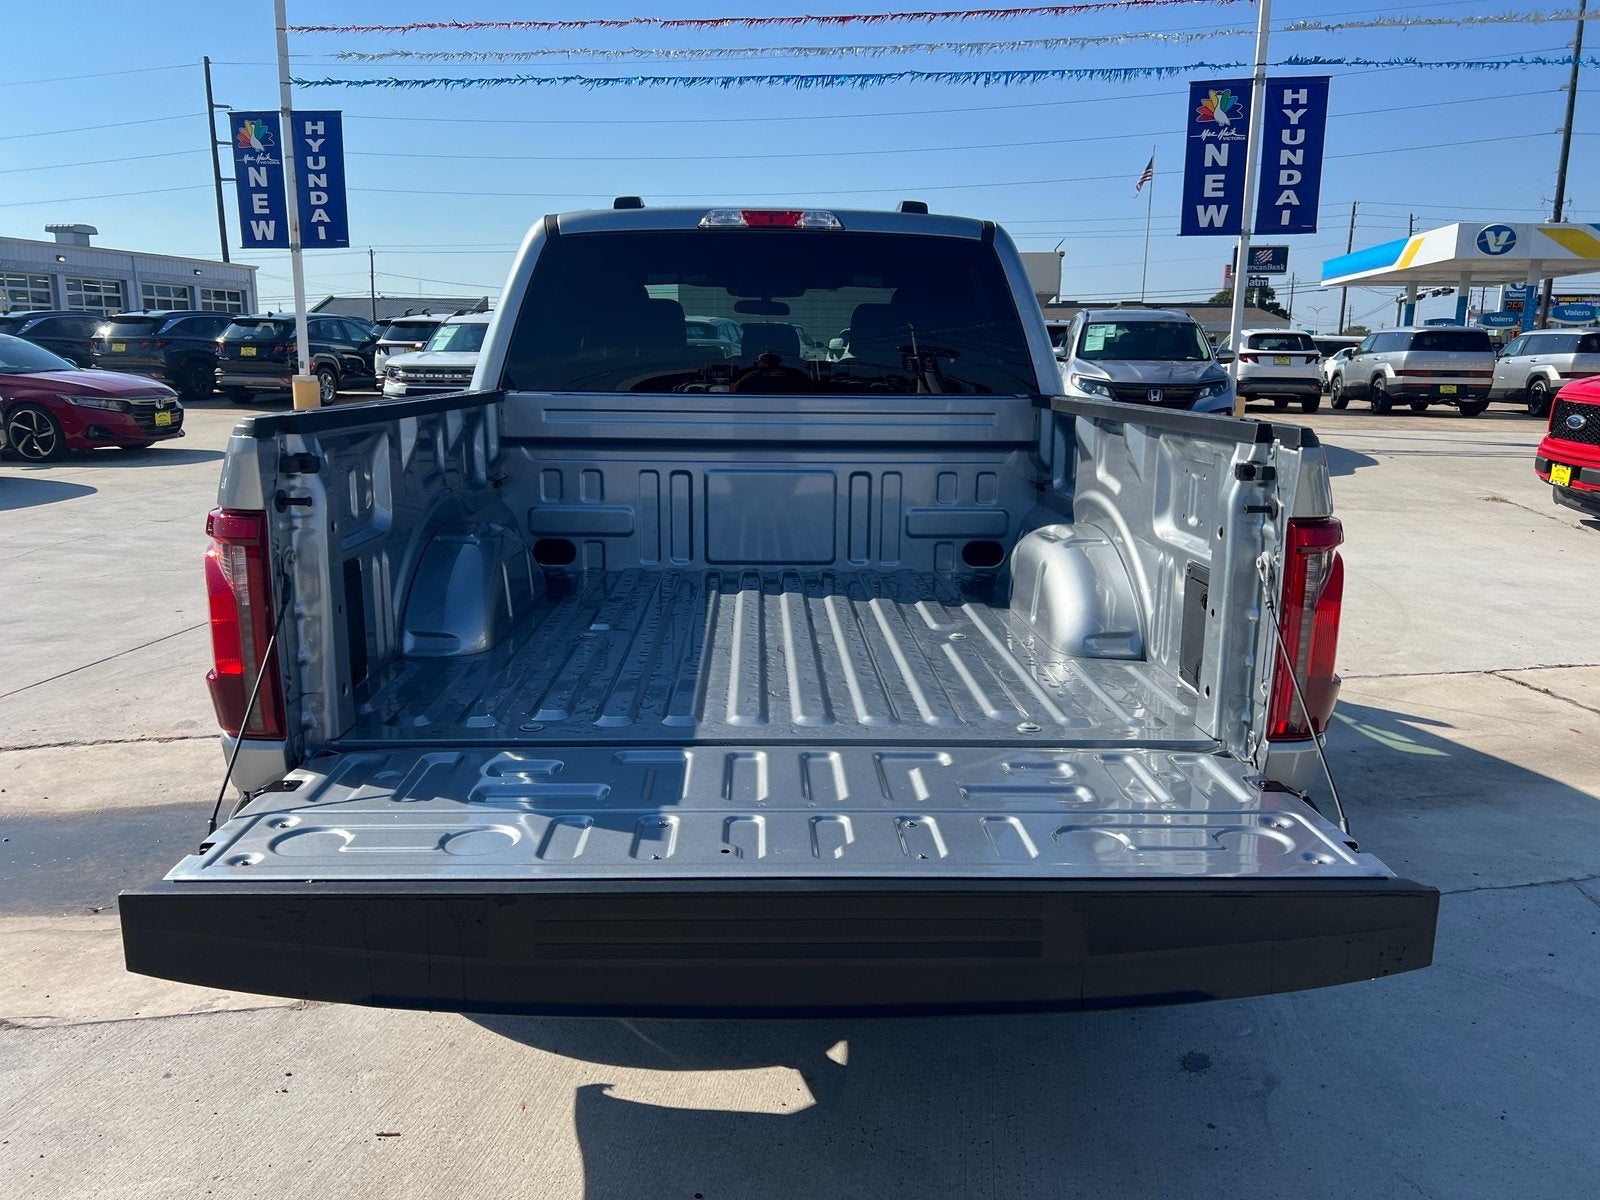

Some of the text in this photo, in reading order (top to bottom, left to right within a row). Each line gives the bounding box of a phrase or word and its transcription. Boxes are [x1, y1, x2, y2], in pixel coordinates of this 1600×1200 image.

[304, 120, 331, 240] HYUNDAI
[1196, 143, 1229, 228] NEW
[1274, 88, 1308, 226] HYUNDAI
[248, 166, 275, 241] NEW
[1248, 279, 1268, 287] atm
